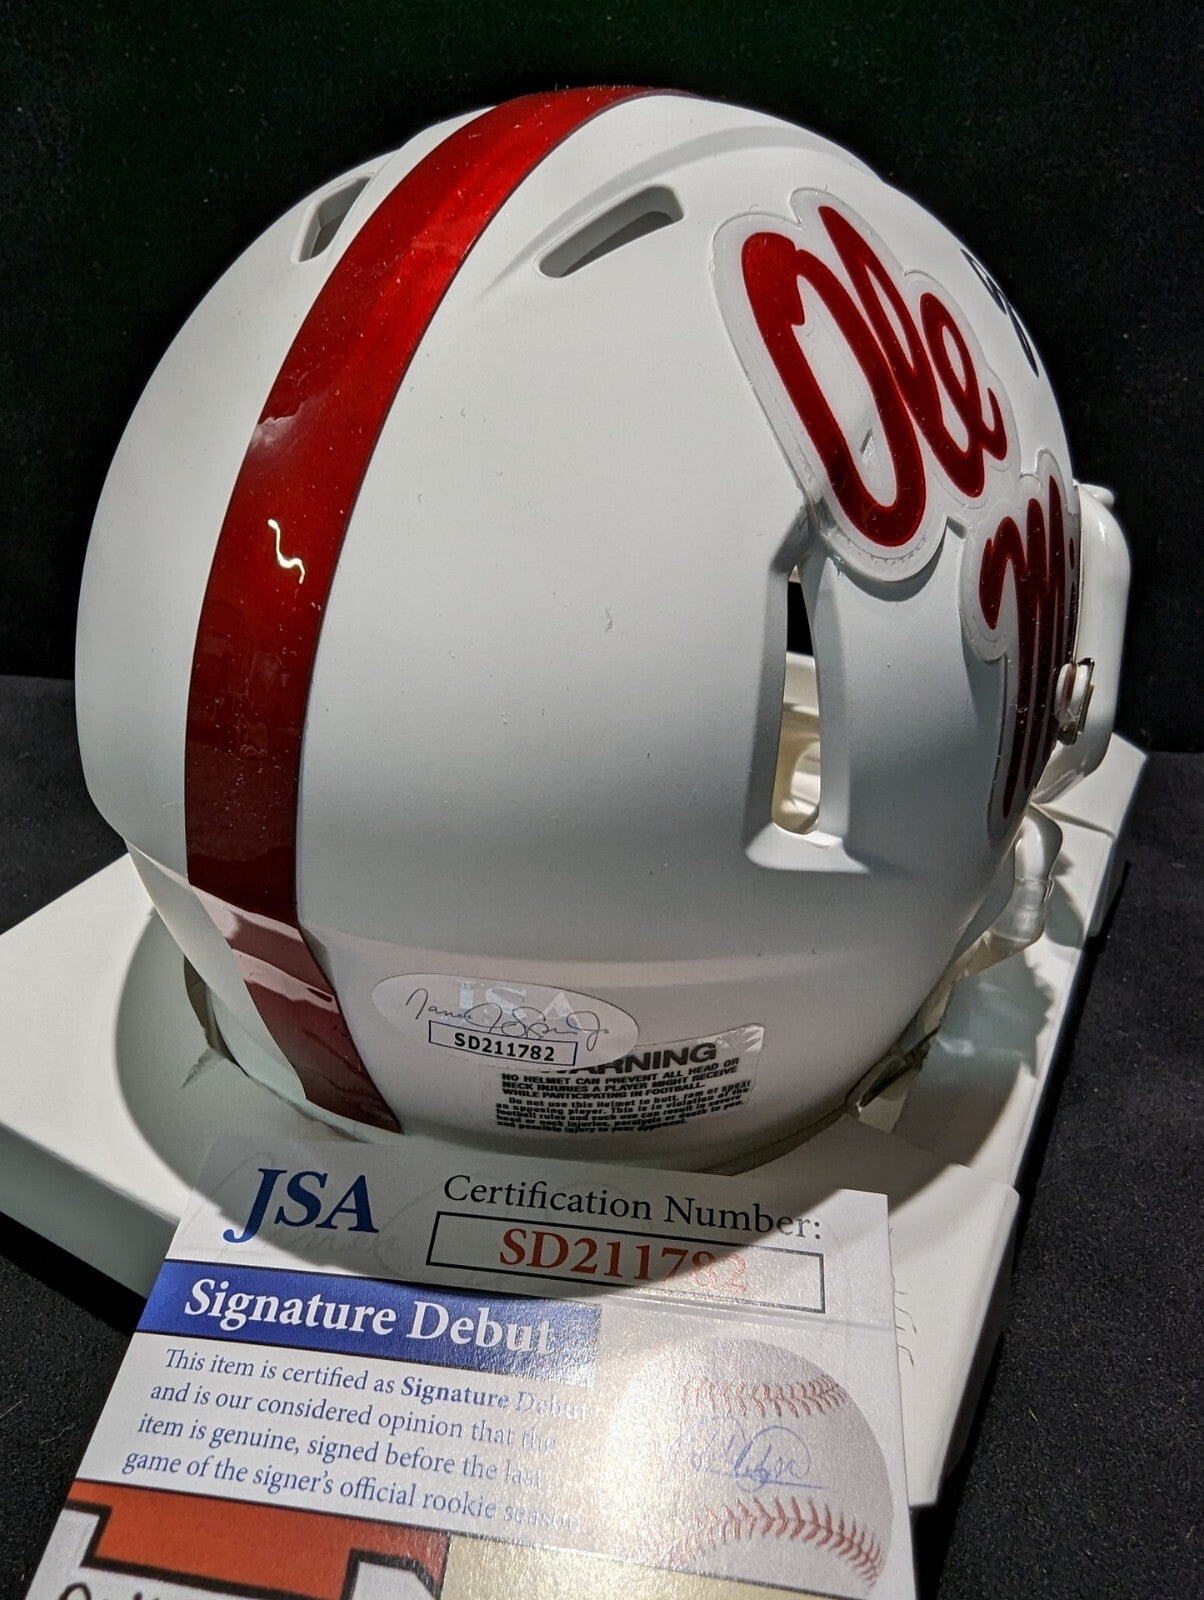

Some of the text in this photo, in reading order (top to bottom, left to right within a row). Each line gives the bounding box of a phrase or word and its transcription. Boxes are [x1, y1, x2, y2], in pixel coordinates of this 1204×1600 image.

[741, 204, 1008, 547] Ole
[454, 1032, 554, 1062] SD211782
[502, 1057, 739, 1085] NO HELMET CAN PREVENT ALL HEAD OR
[502, 1082, 533, 1090] NECK
[537, 1084, 588, 1092] INJURIES
[605, 1082, 648, 1092] PLAYER
[652, 1077, 688, 1087] MIGHT
[692, 1065, 738, 1081] RECEIVE
[502, 1082, 706, 1100] WHILE PARTICIPATING IN FOOTBALL.
[640, 1097, 650, 1105] to
[222, 1168, 379, 1243] JSA
[444, 1174, 821, 1240] Certification Number:
[500, 1228, 747, 1292] SD211782
[184, 1277, 555, 1356] Signature Debut
[150, 1382, 557, 1452] and is our considered opinion that the
[166, 1348, 589, 1421] This item is certified as Signature Debut
[138, 1413, 542, 1487] item is genuine, signed before the last
[122, 1452, 582, 1532] game of the signer’s official rookie season
